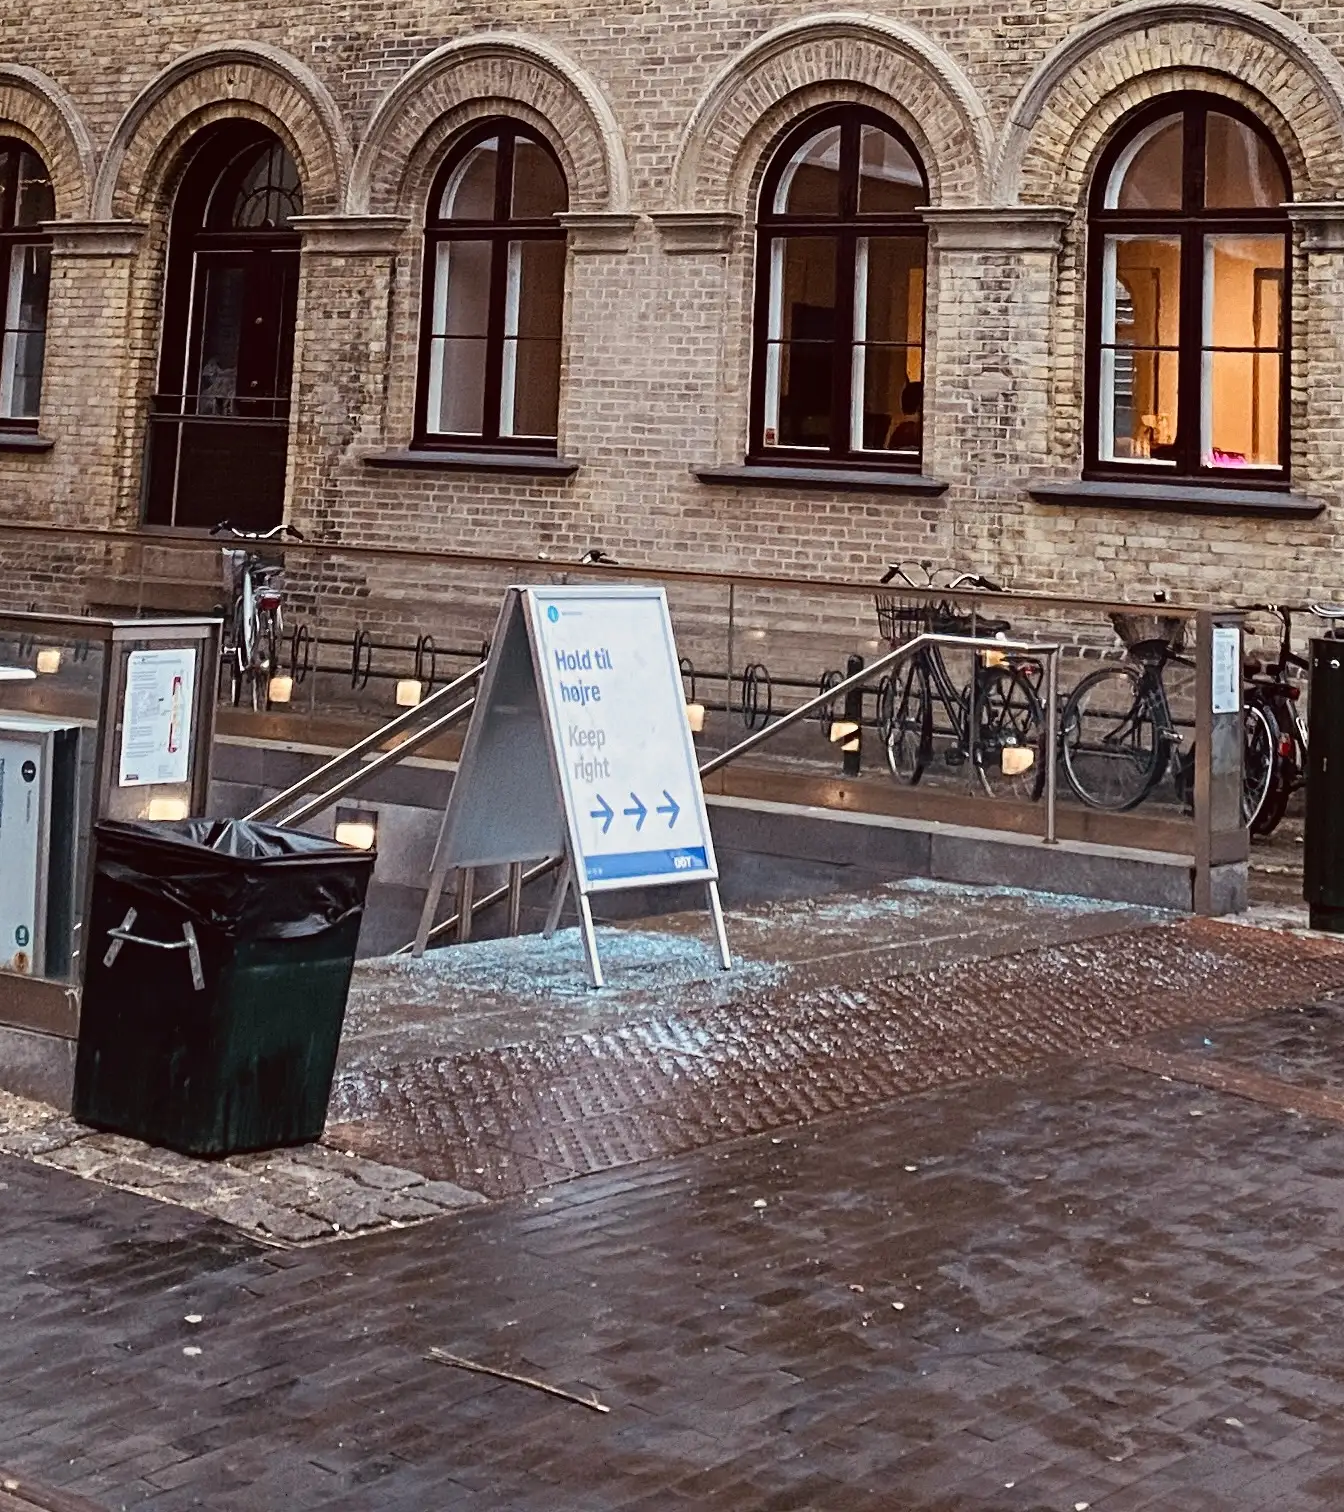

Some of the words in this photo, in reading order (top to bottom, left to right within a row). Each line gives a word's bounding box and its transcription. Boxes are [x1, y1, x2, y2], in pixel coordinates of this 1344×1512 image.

[555, 648, 592, 671] Hold
[594, 648, 613, 670] til
[560, 680, 601, 706] højre
[568, 725, 606, 750] Keep
[574, 756, 611, 783] right
